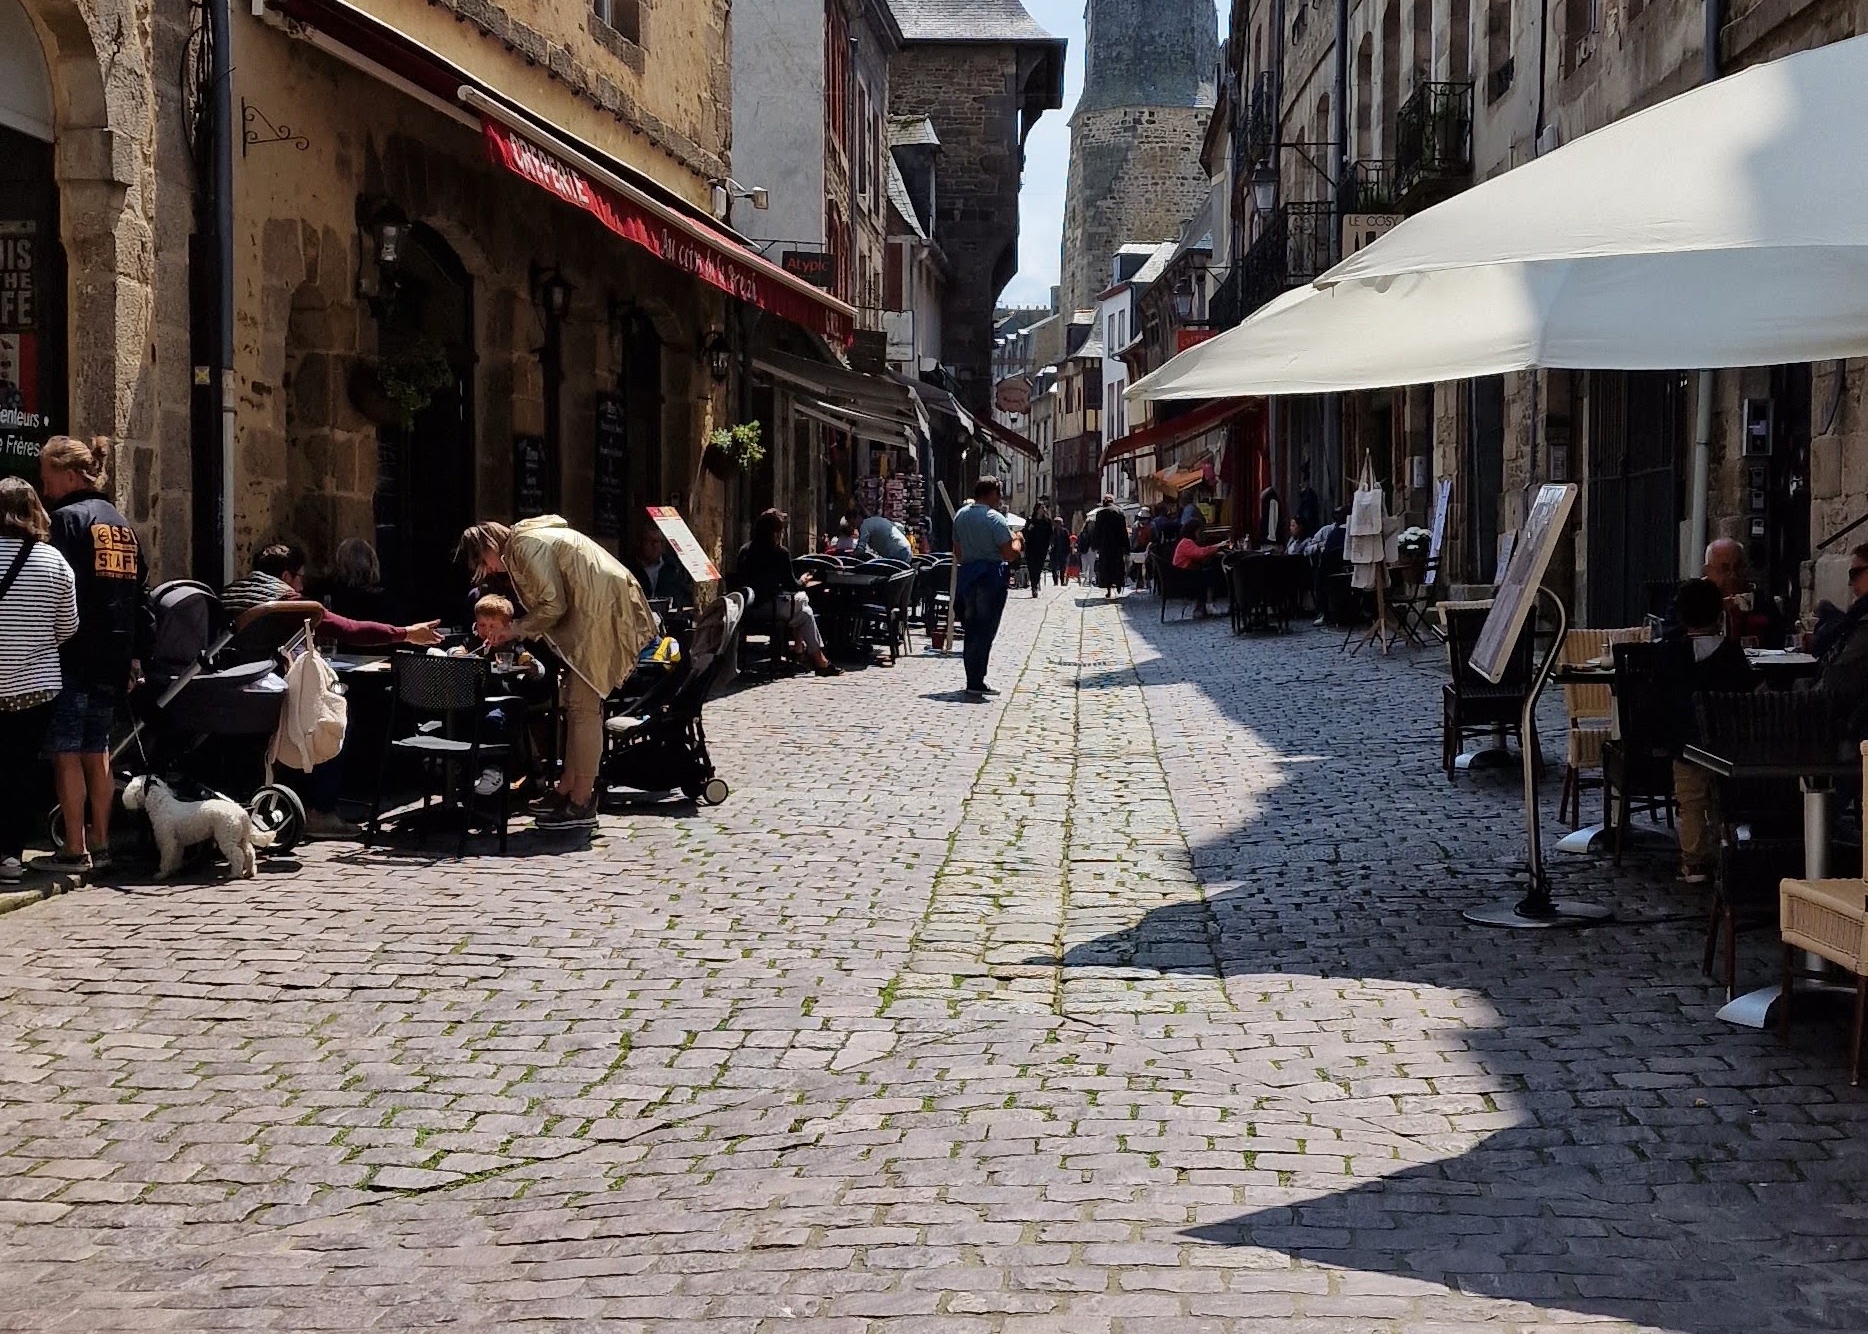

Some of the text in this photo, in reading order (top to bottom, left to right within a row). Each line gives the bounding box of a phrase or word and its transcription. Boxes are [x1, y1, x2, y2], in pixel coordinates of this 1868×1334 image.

[1348, 215, 1400, 227] LE COSY
[0, 272, 32, 290] HE
[0, 404, 40, 429] enteurs
